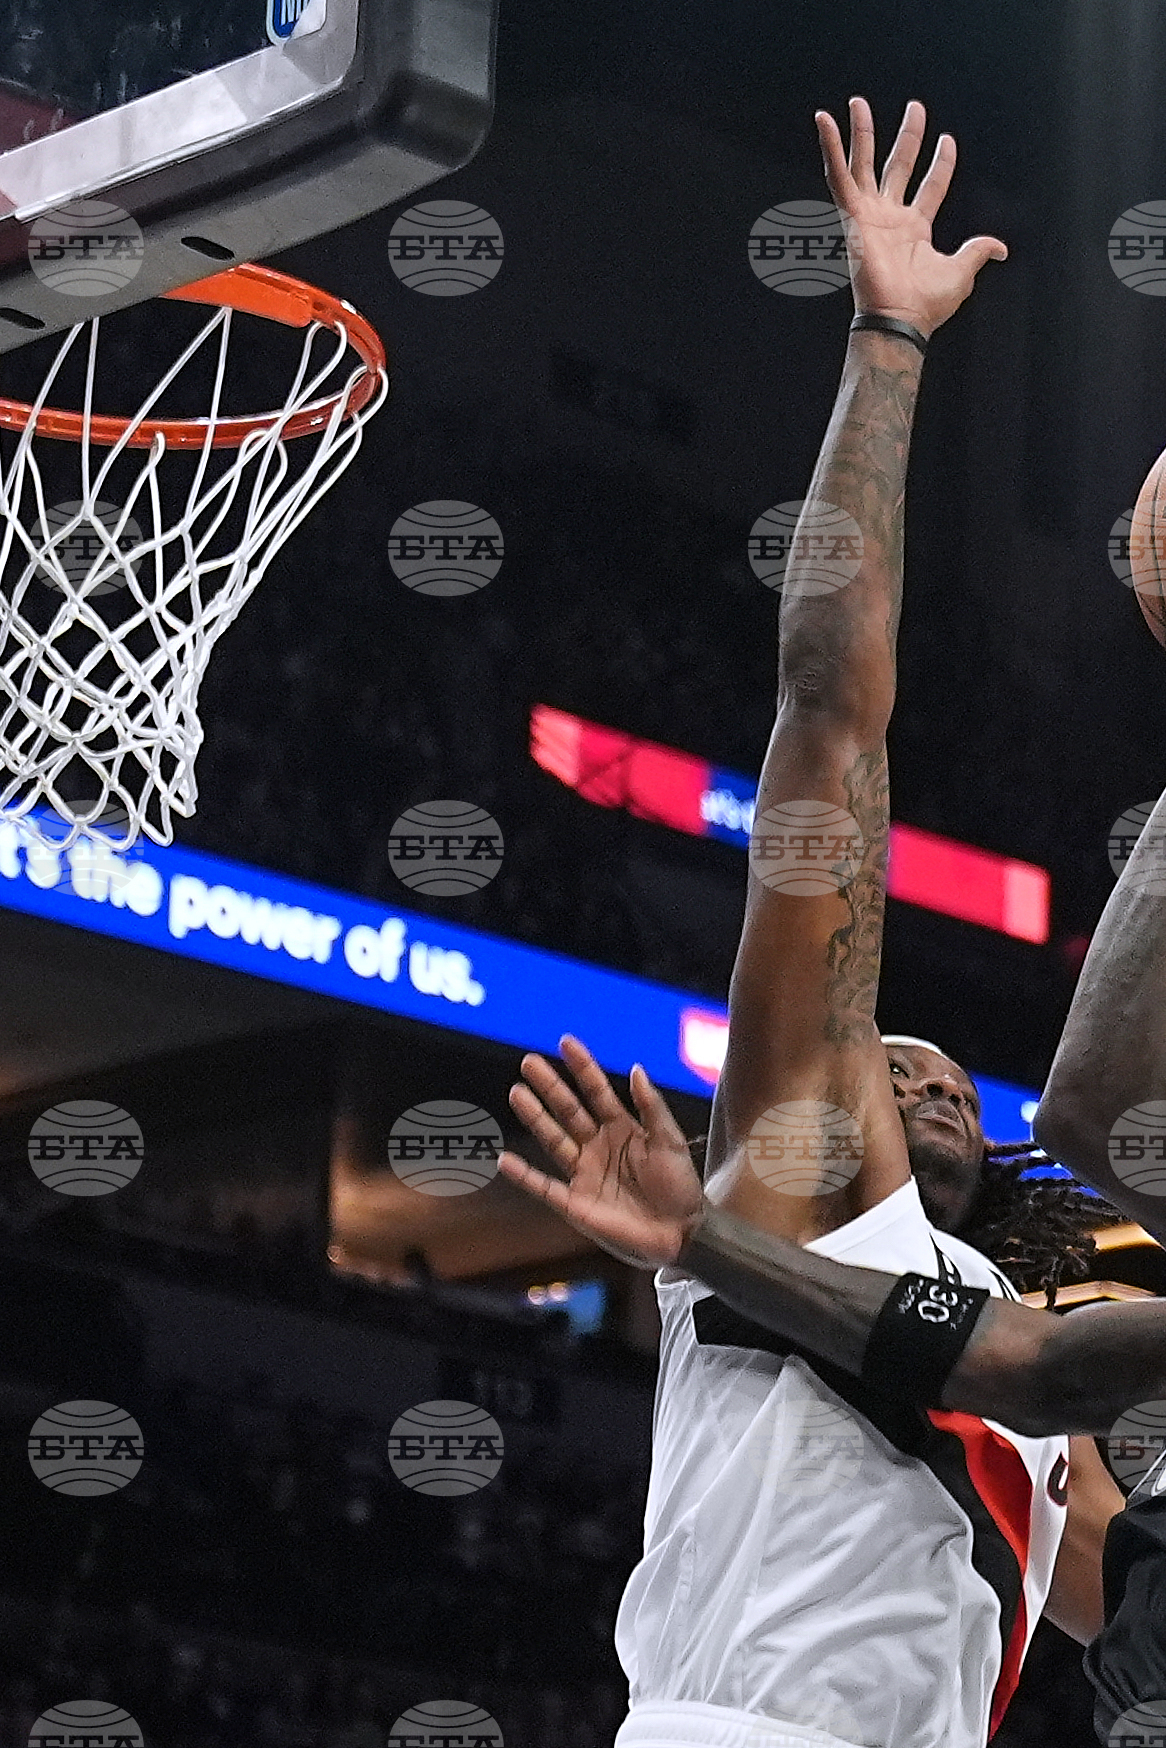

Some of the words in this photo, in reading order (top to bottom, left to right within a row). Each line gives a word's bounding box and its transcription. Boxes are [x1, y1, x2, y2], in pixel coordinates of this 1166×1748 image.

[168, 873, 342, 964] power
[344, 916, 407, 983] of
[409, 941, 486, 1007] us.
[918, 1285, 958, 1323] 30
